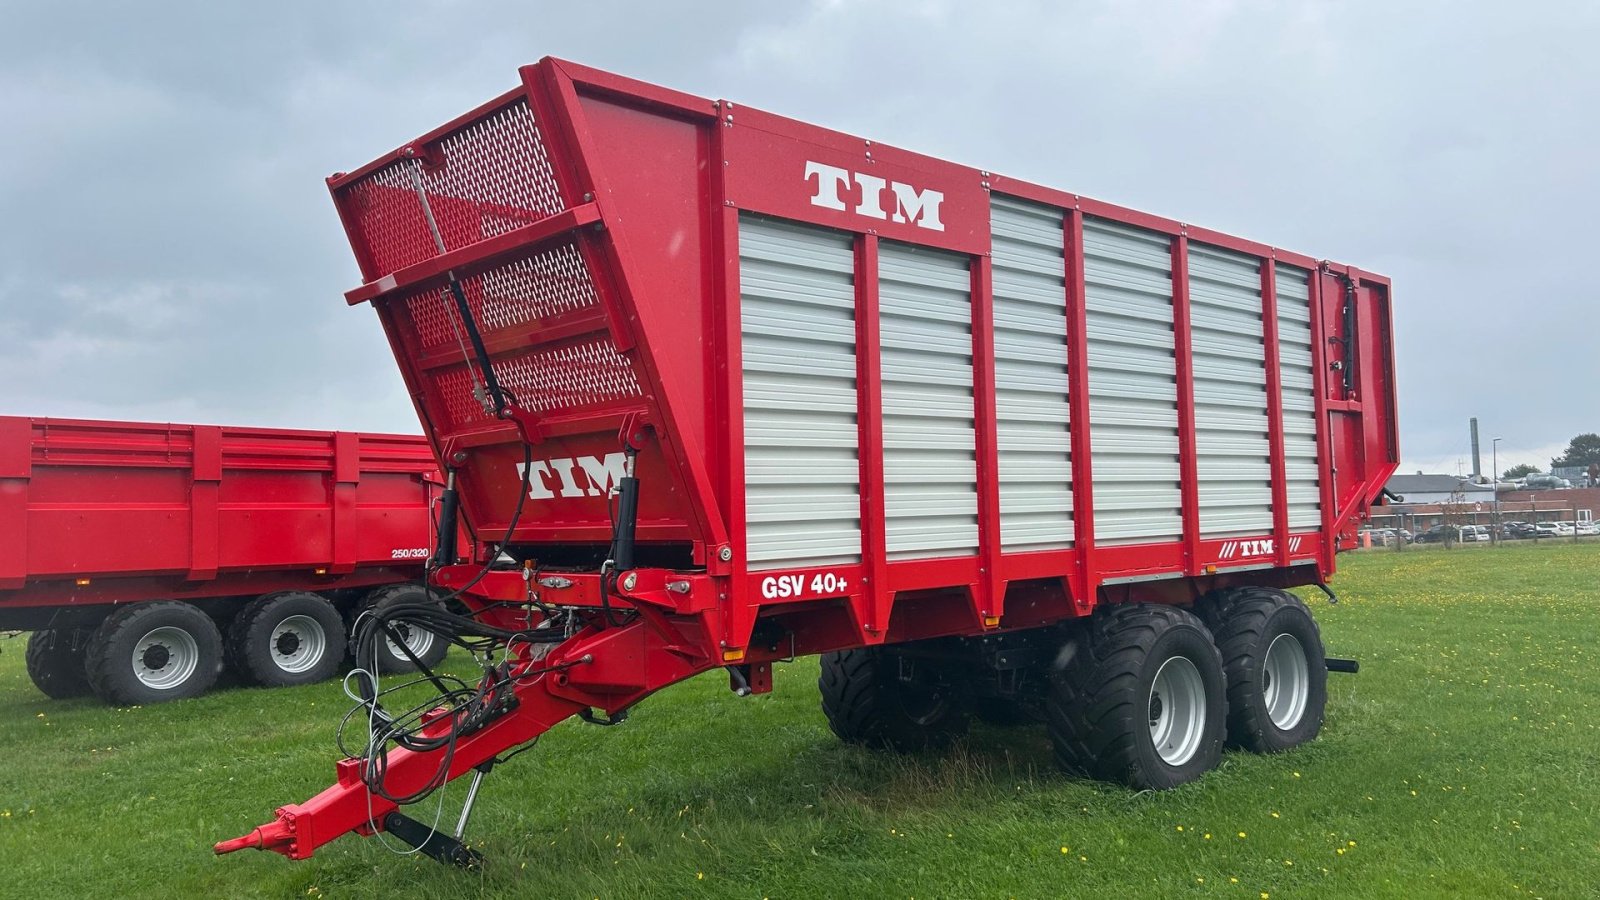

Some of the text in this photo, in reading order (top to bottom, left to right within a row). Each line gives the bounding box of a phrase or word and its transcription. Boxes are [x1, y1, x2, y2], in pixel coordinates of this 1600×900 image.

[804, 160, 945, 232] TIM
[515, 452, 628, 500] TIM
[391, 547, 429, 559] 250/320
[1239, 539, 1274, 557] TIM
[761, 572, 848, 599] GSV 40+
